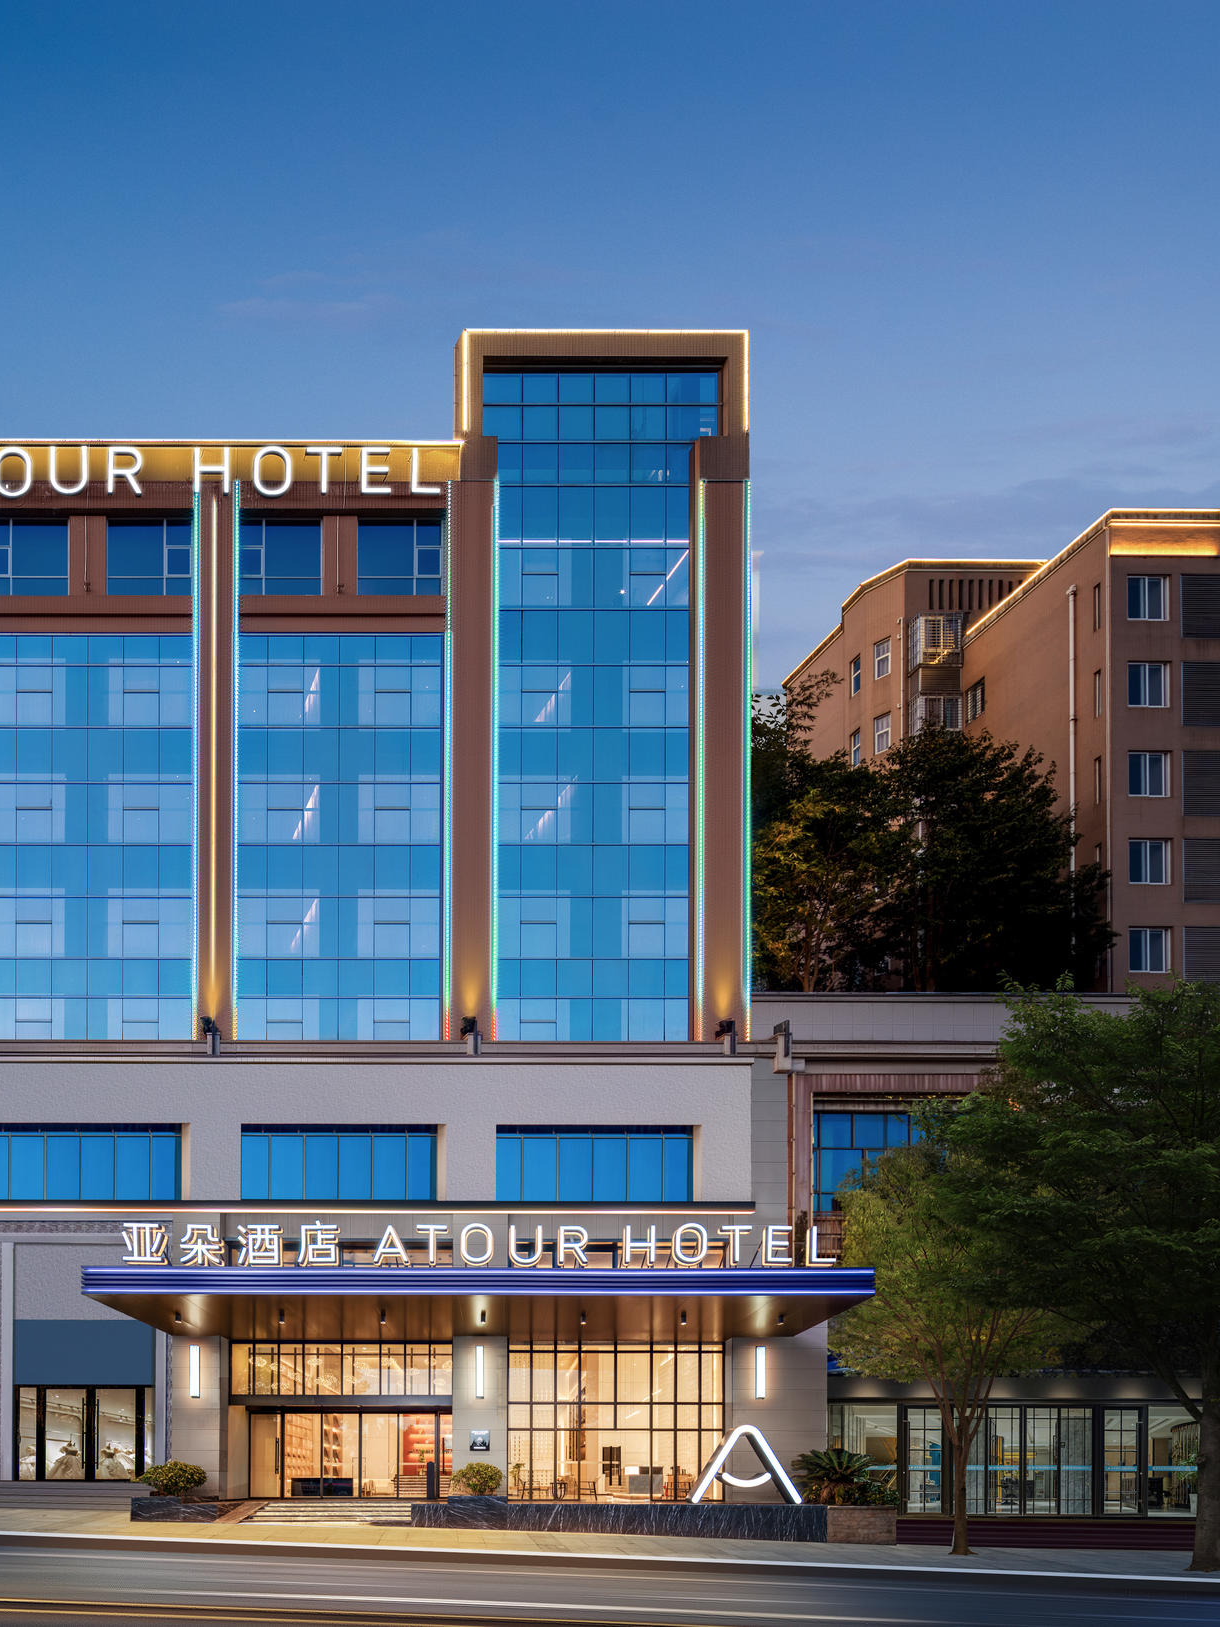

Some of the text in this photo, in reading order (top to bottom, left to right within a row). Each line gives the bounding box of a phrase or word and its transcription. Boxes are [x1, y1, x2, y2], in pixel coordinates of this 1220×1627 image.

[193, 445, 443, 496] HOTEL
[121, 1221, 840, 1267] 亚朵酒店 ATOUR HOTEL
